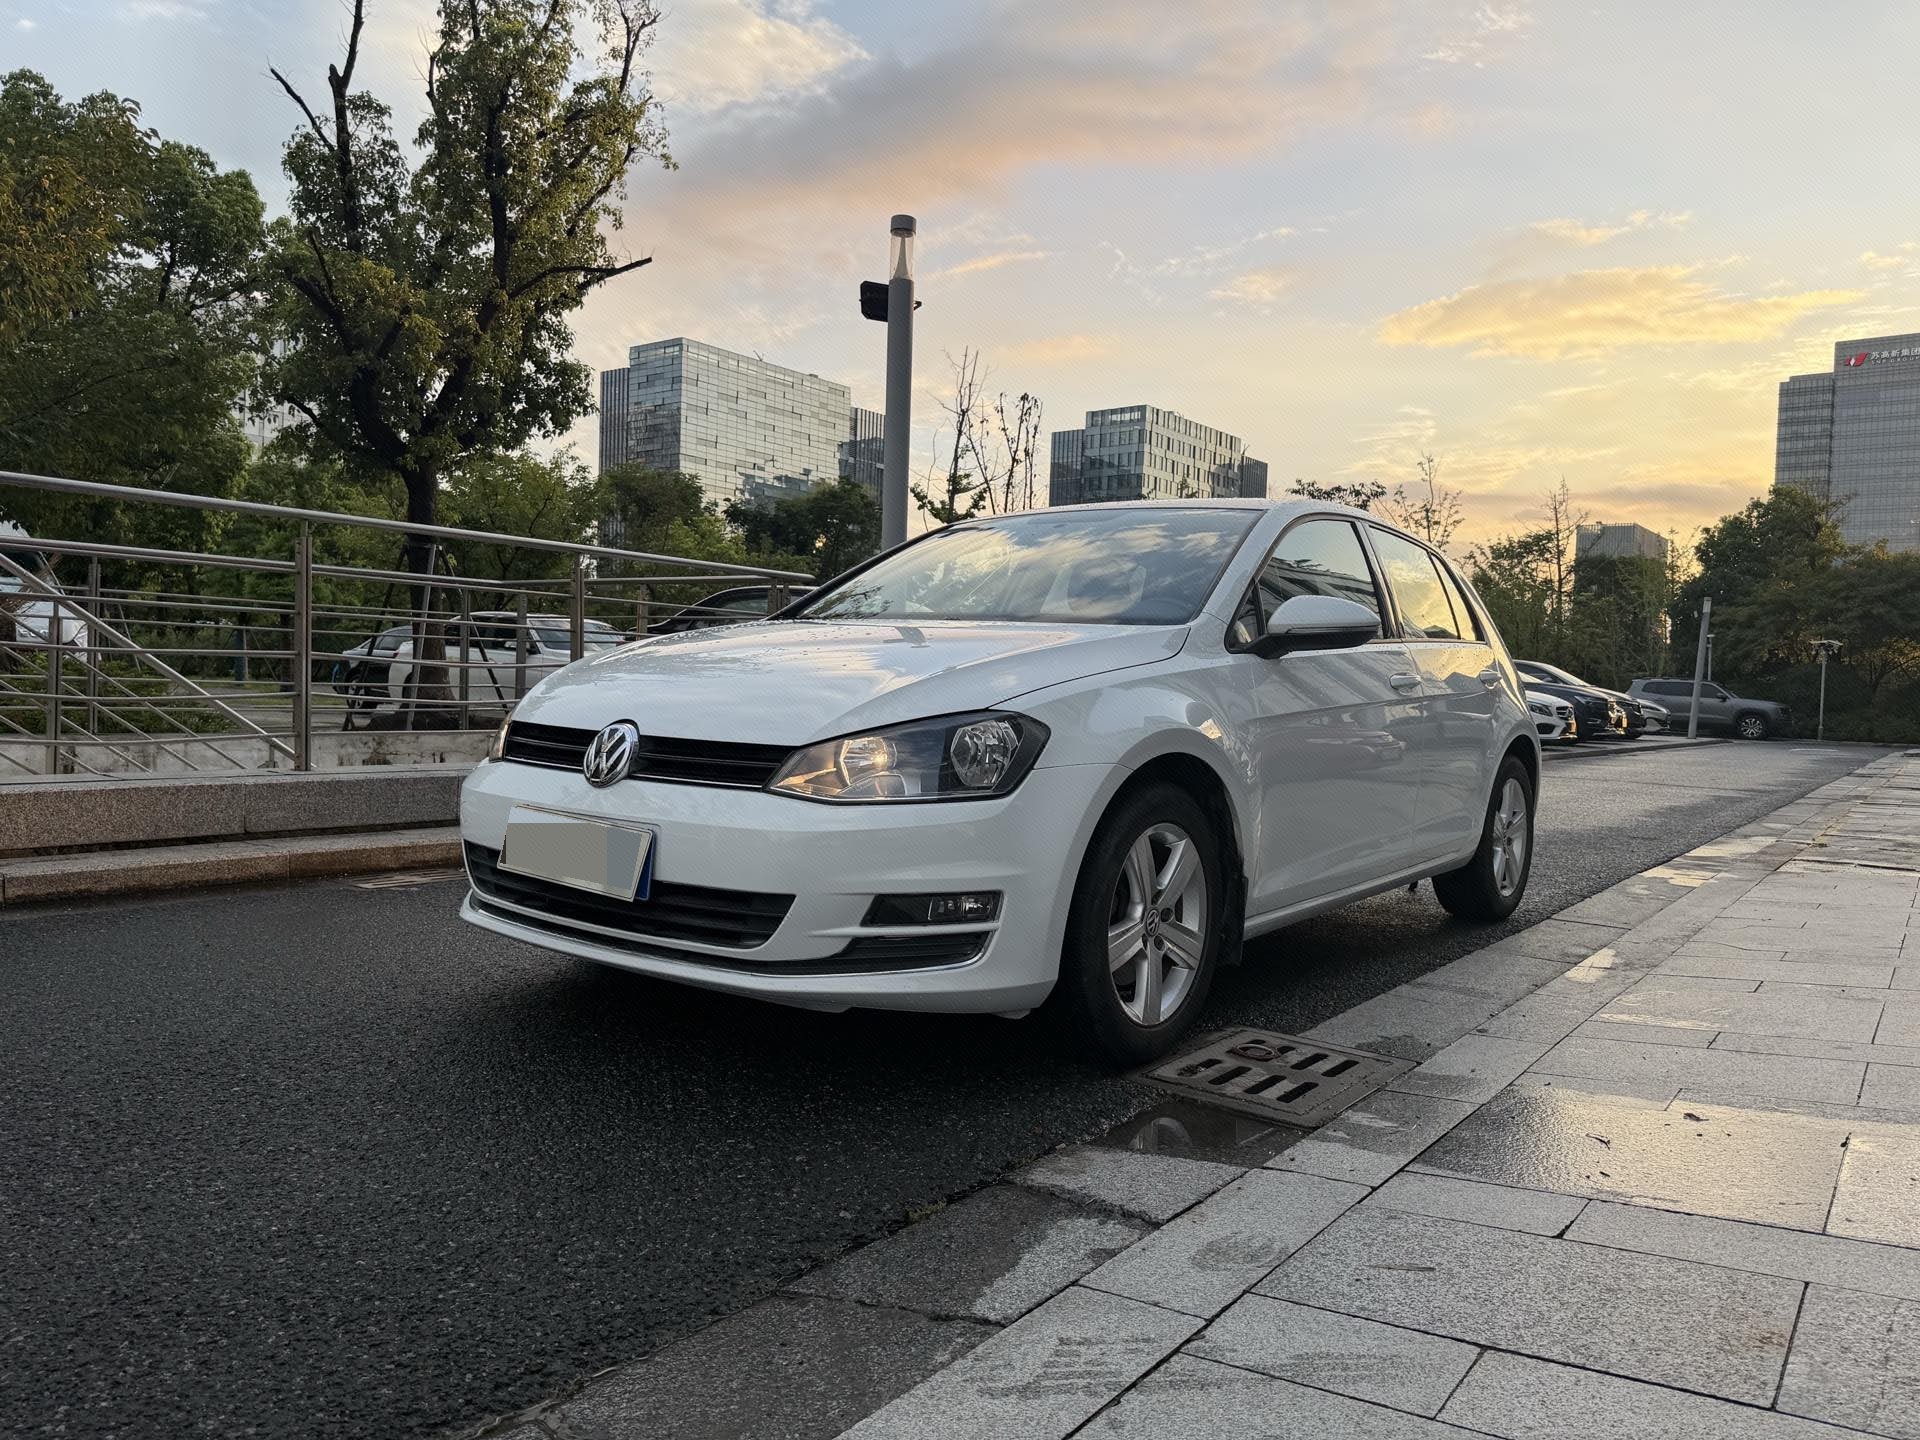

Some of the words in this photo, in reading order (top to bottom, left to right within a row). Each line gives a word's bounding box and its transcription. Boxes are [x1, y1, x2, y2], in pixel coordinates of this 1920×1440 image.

[1871, 348, 1920, 360] 苏高新集团
